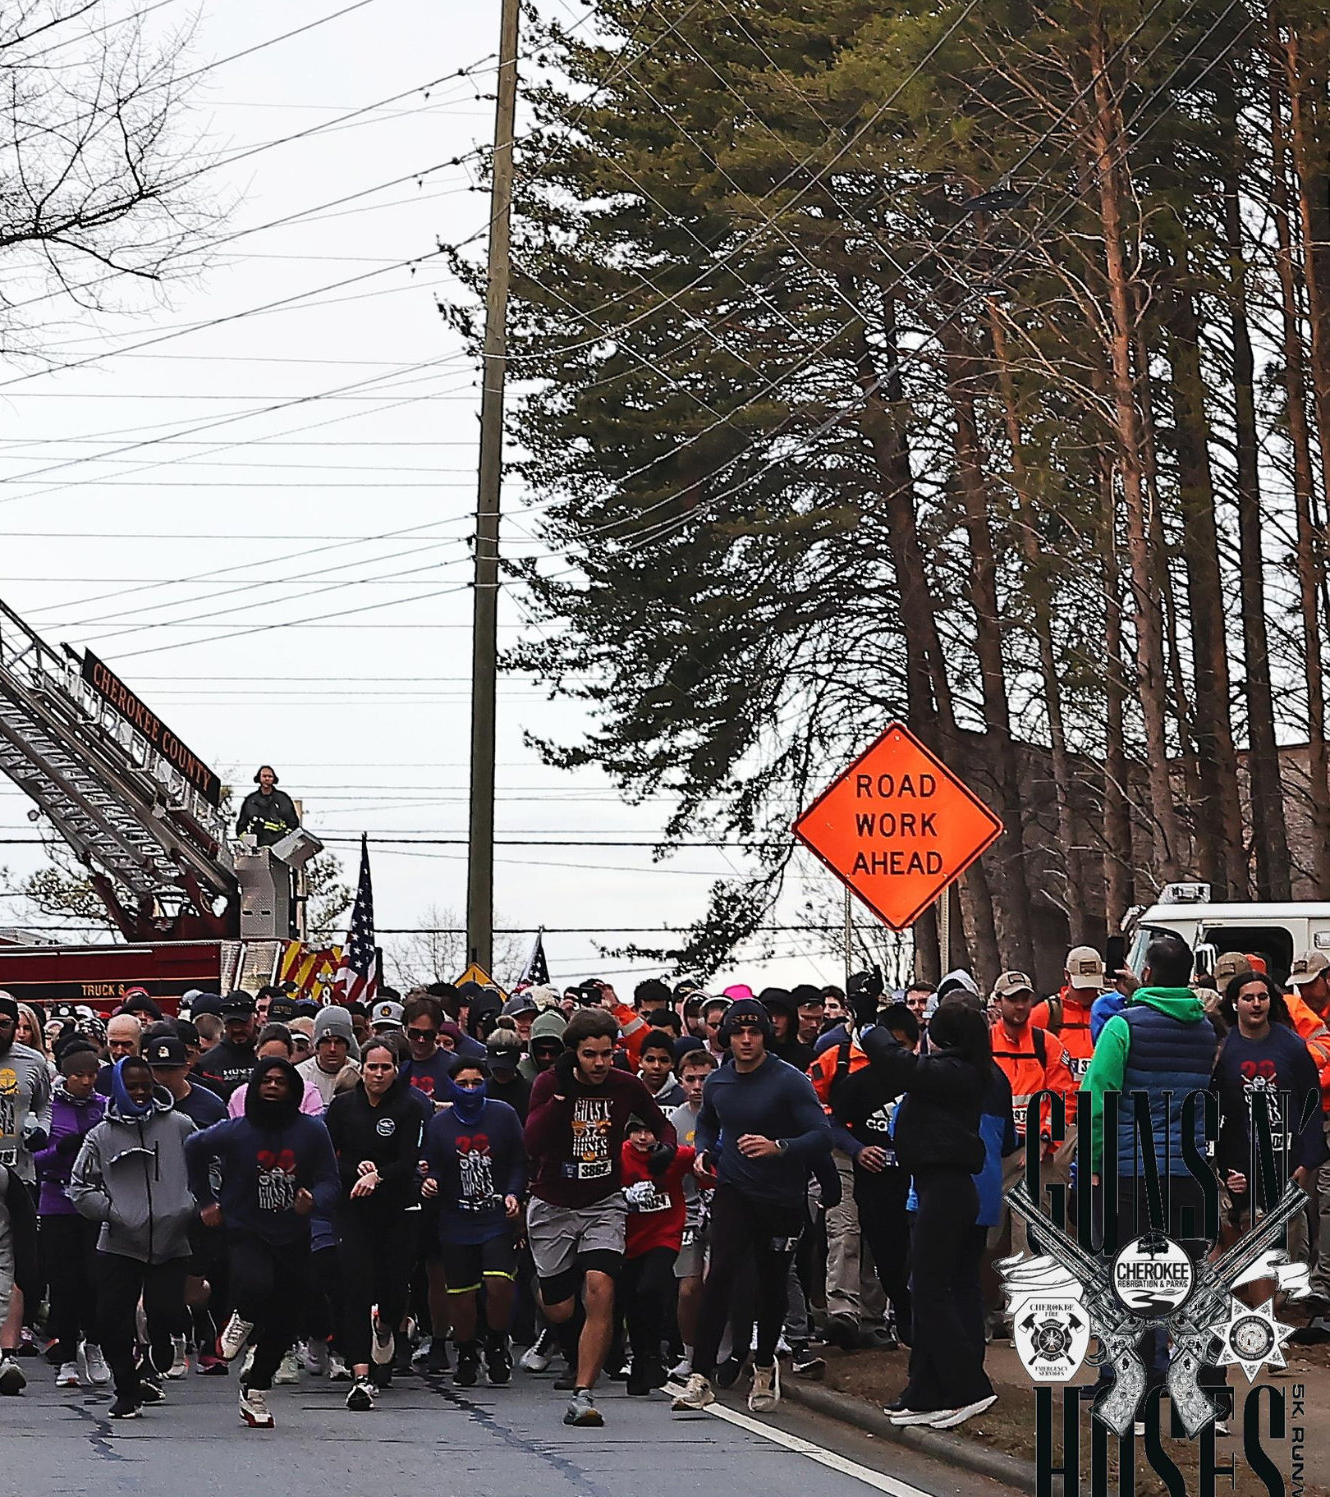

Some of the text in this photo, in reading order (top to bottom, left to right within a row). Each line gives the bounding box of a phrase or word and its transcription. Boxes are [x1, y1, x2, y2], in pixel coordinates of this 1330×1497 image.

[93, 662, 213, 792] CHEROKEE COUNTY
[856, 774, 937, 799] ROAD
[855, 813, 938, 837] WORK
[851, 851, 943, 876] AHEAD
[81, 984, 116, 996] TRUCK
[322, 986, 331, 1007] 8
